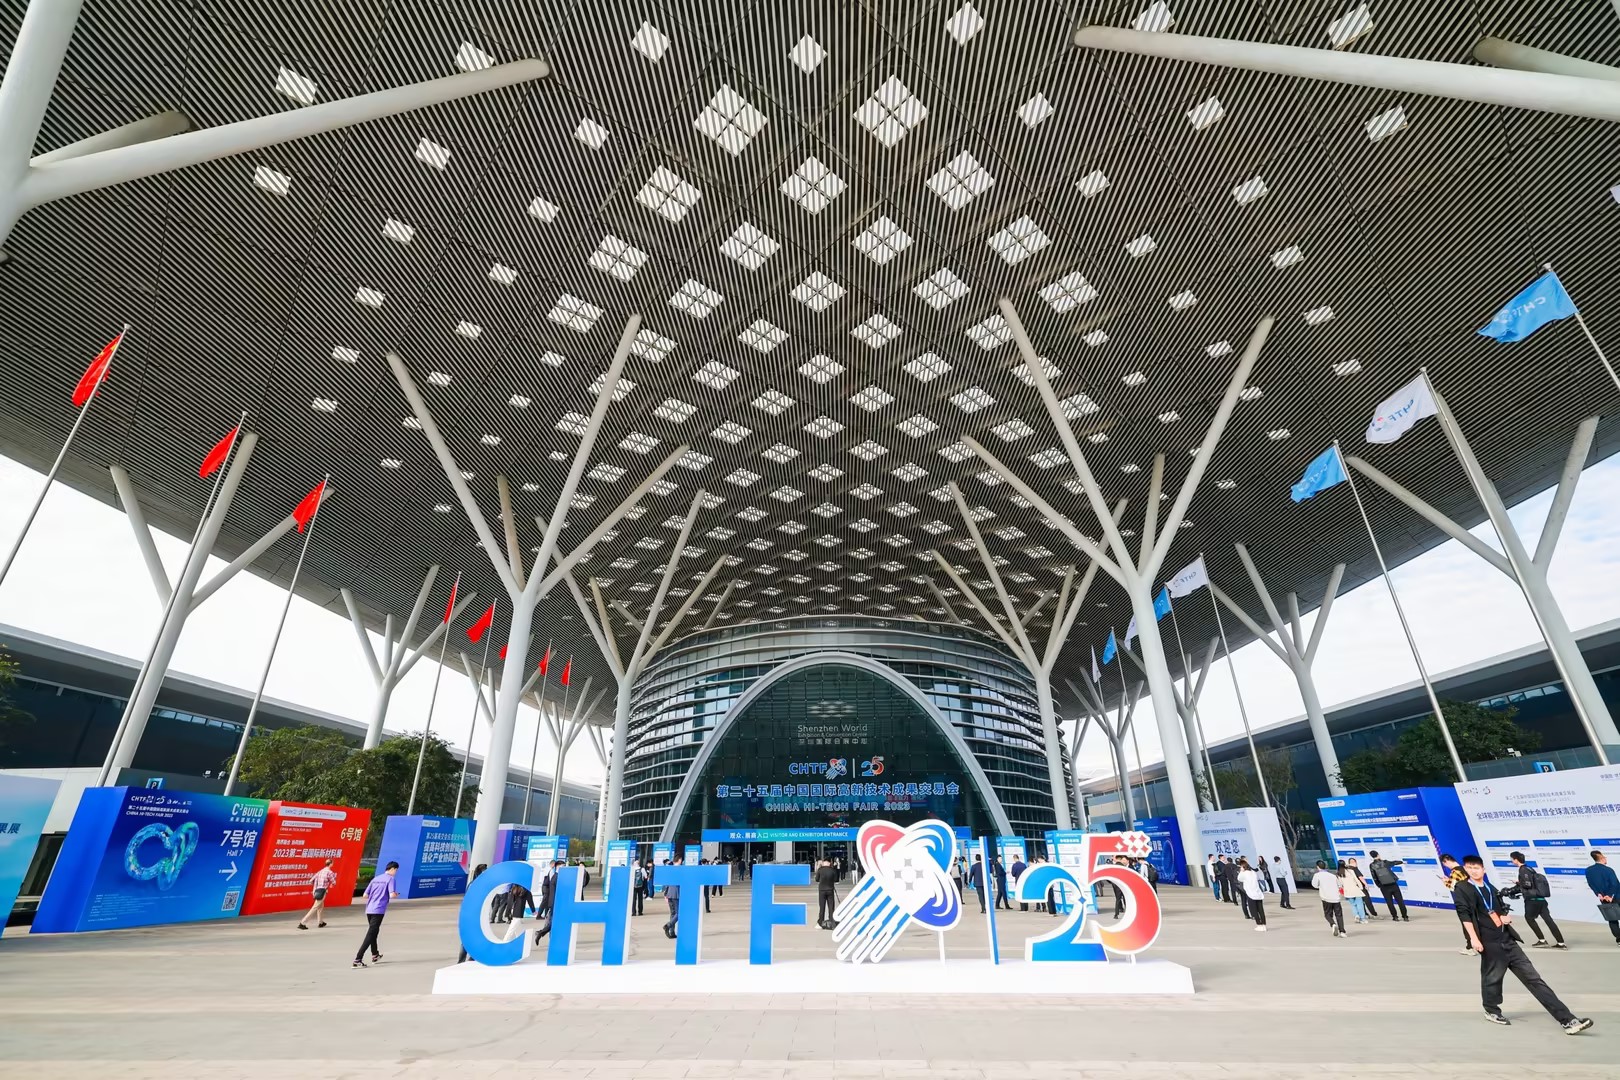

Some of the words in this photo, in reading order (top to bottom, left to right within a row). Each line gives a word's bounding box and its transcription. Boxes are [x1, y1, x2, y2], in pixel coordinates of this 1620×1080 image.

[797, 724, 839, 733] Shenzhen
[841, 723, 868, 732] World
[788, 762, 828, 775] CHTF
[716, 782, 960, 798] 第二十五届中国国际高新技术成果交易会
[765, 803, 800, 812] CHINA
[803, 802, 849, 812] HI-TECH
[853, 802, 879, 811] FAIR
[883, 802, 911, 811] 2023
[220, 829, 258, 849] 7号馆
[340, 827, 363, 842] 6号馆
[226, 849, 239, 857] Hall
[1214, 838, 1240, 855] 欢迎您
[458, 860, 811, 967] CHTF
[1015, 831, 1162, 963] 25
